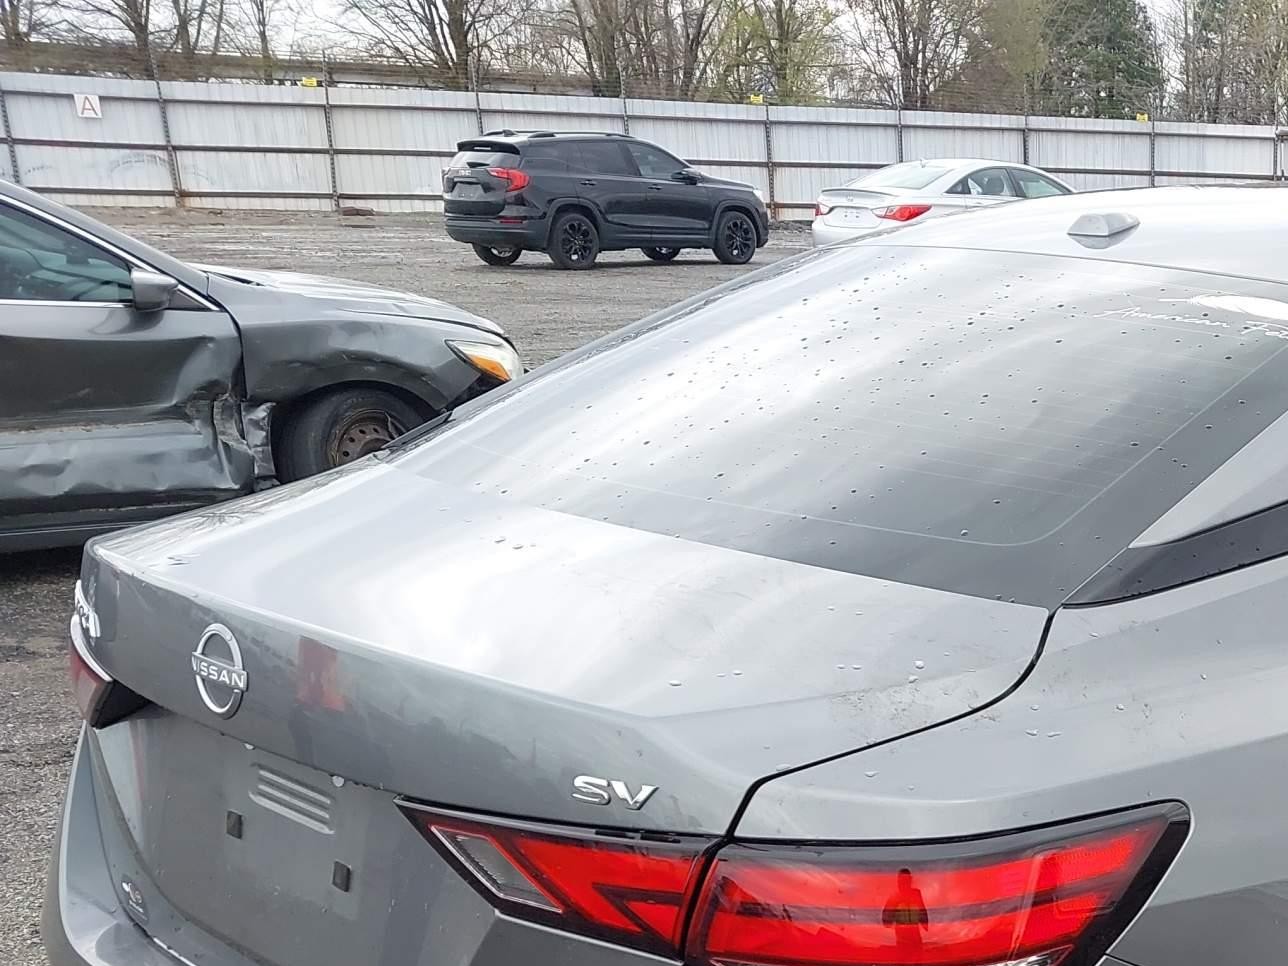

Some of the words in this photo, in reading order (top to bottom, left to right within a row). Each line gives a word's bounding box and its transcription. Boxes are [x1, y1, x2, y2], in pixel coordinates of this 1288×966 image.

[81, 95, 98, 117] A
[191, 655, 244, 688] NISSAN
[571, 774, 660, 811] SV
